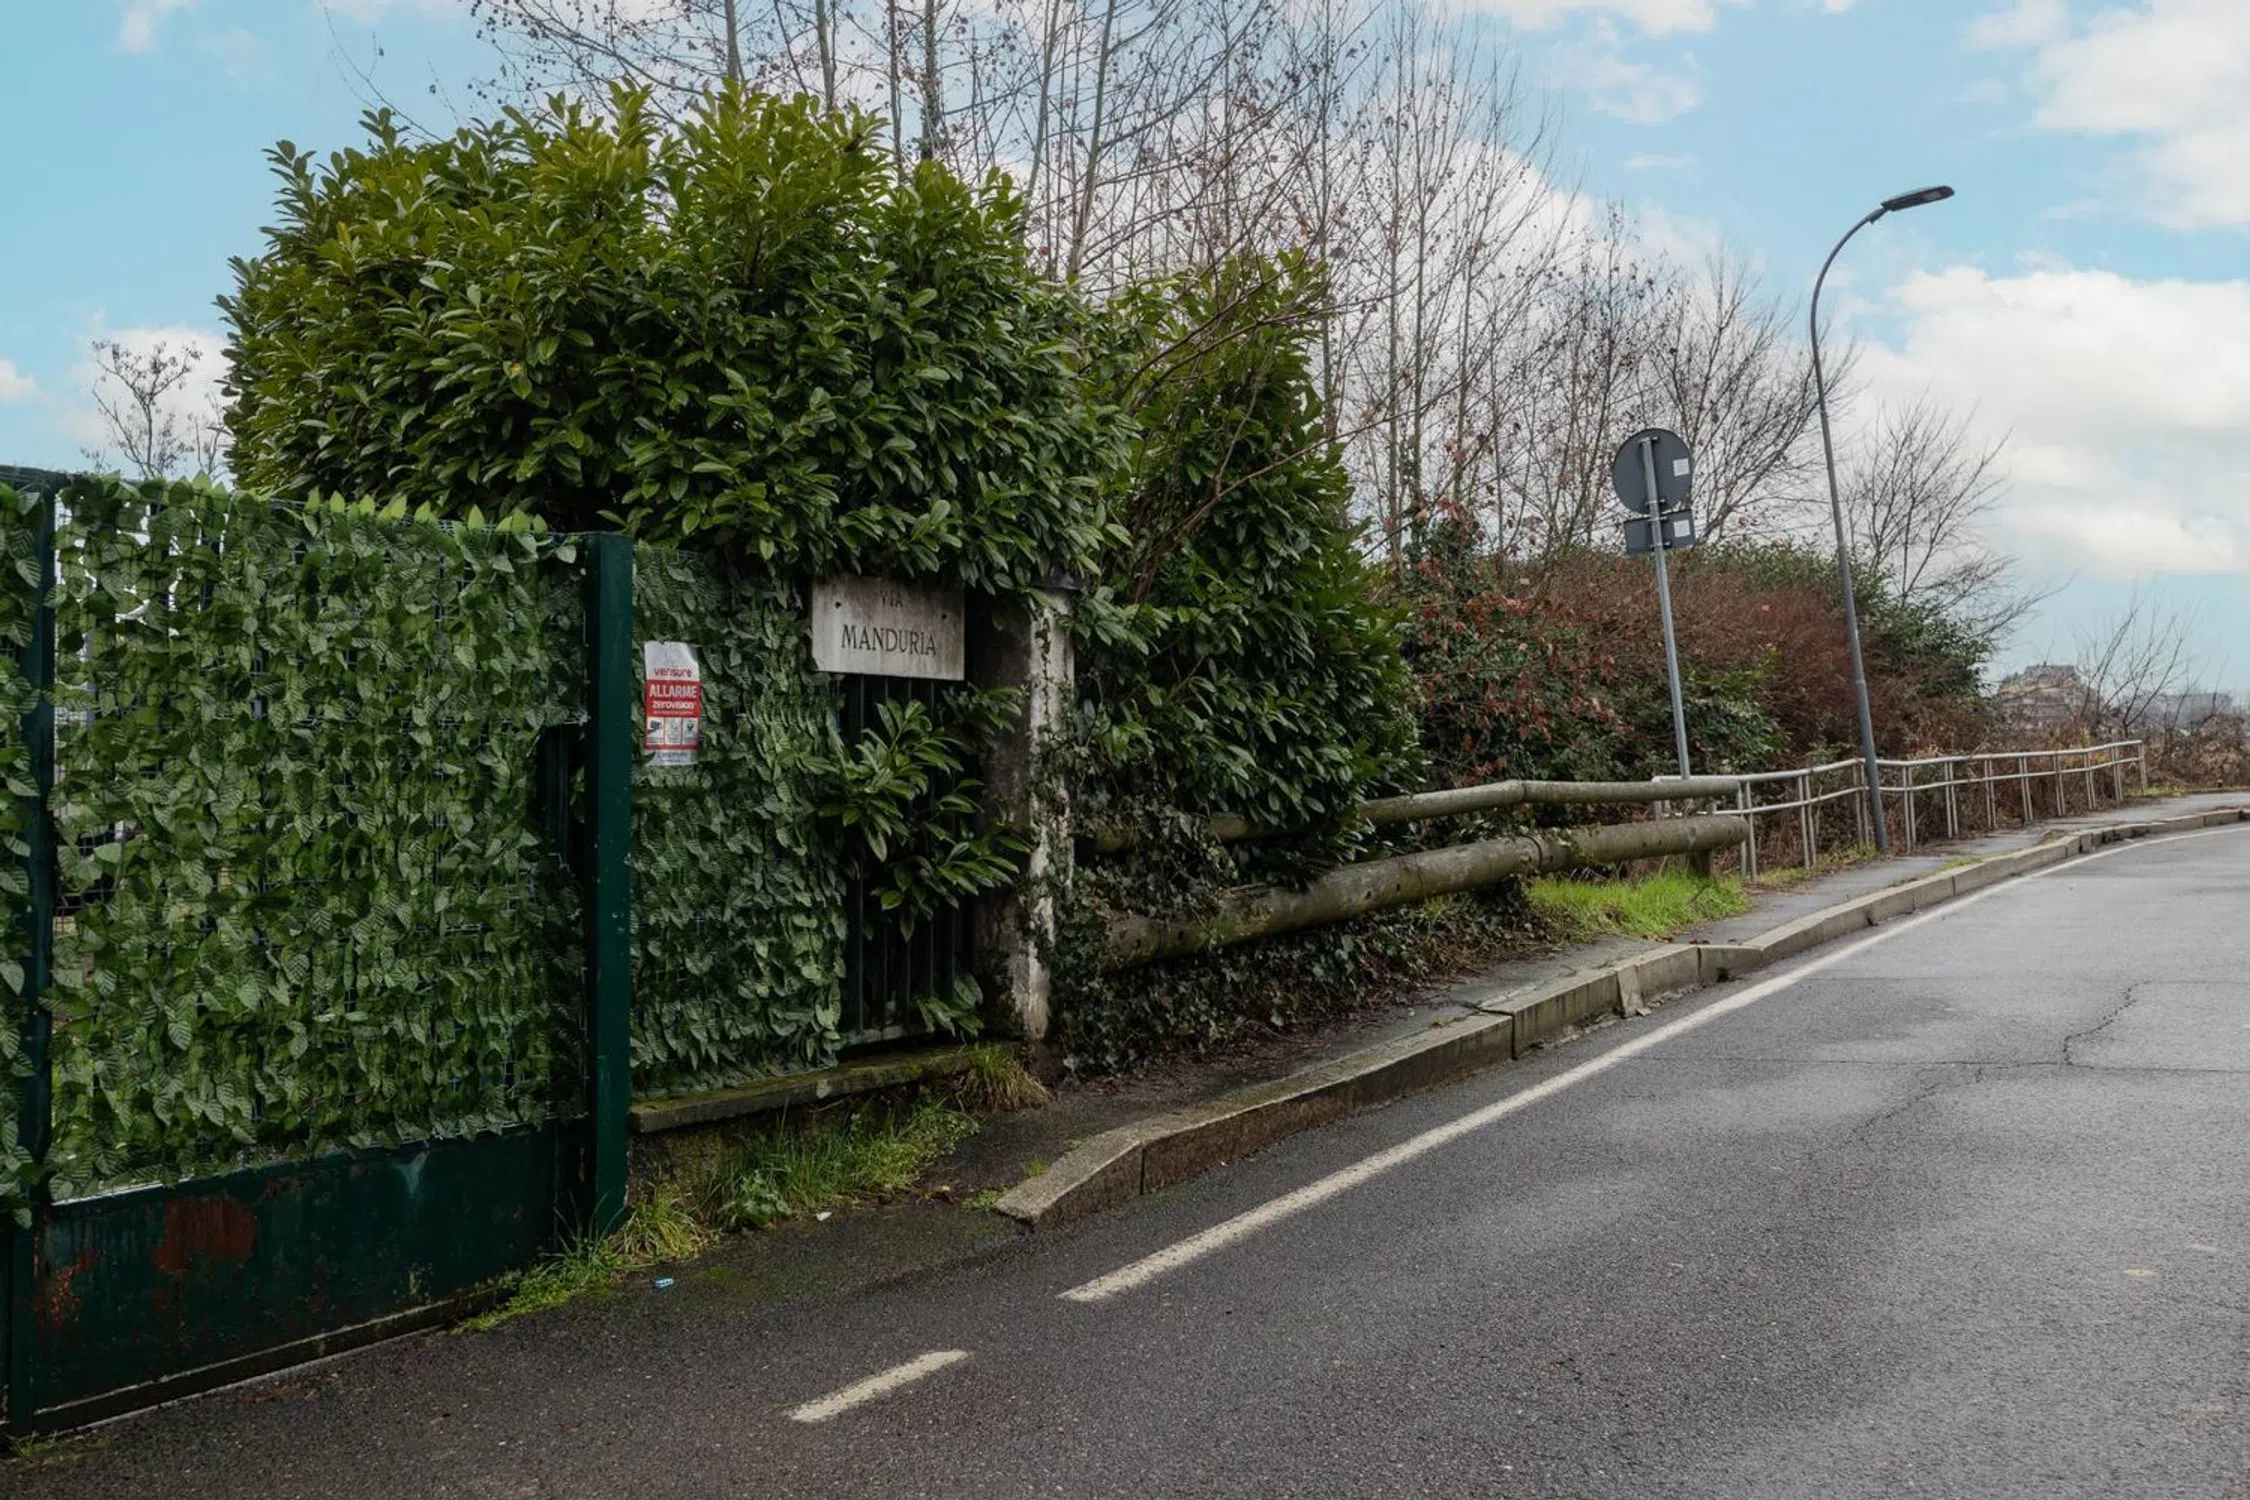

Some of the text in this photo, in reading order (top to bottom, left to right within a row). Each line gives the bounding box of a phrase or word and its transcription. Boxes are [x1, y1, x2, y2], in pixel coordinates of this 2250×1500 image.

[880, 589, 904, 608] VIA
[841, 624, 937, 655] MANDURIA
[649, 684, 697, 698] ALLARME
